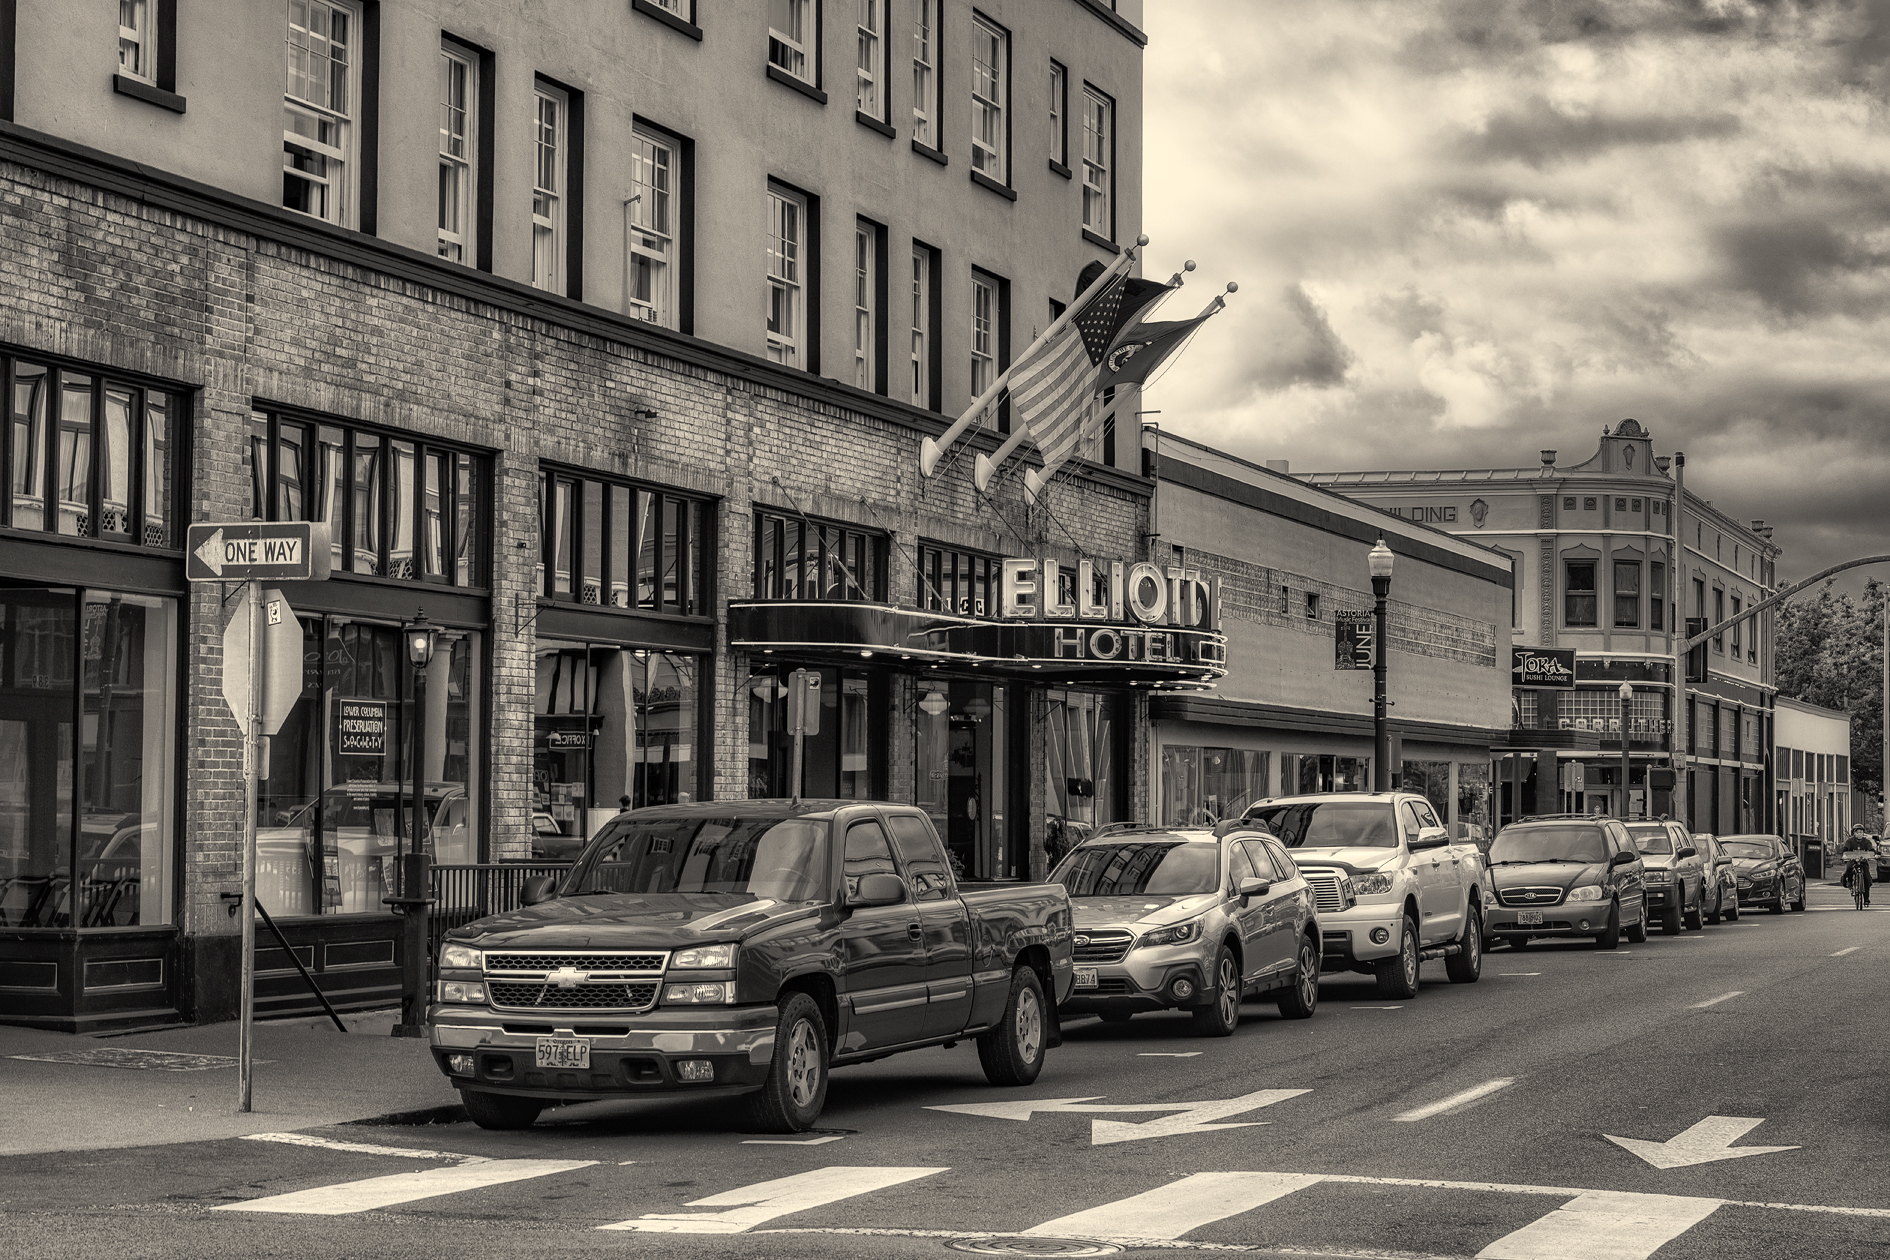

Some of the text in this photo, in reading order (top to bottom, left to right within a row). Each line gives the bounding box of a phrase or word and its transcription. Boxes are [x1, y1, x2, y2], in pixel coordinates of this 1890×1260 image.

[225, 540, 297, 562] ONE WAY
[1002, 558, 1201, 626] ELLIOTT
[1336, 609, 1371, 617] ASTORIA
[1054, 628, 1184, 663] HOTEL
[1356, 624, 1372, 670] JUNE
[1515, 651, 1562, 682] TORA
[1544, 674, 1568, 682] LOUNGE
[343, 706, 383, 718] LOWER COLUMBIA
[343, 719, 383, 733] PRESERVATION
[538, 1044, 587, 1062] 597 ELP
